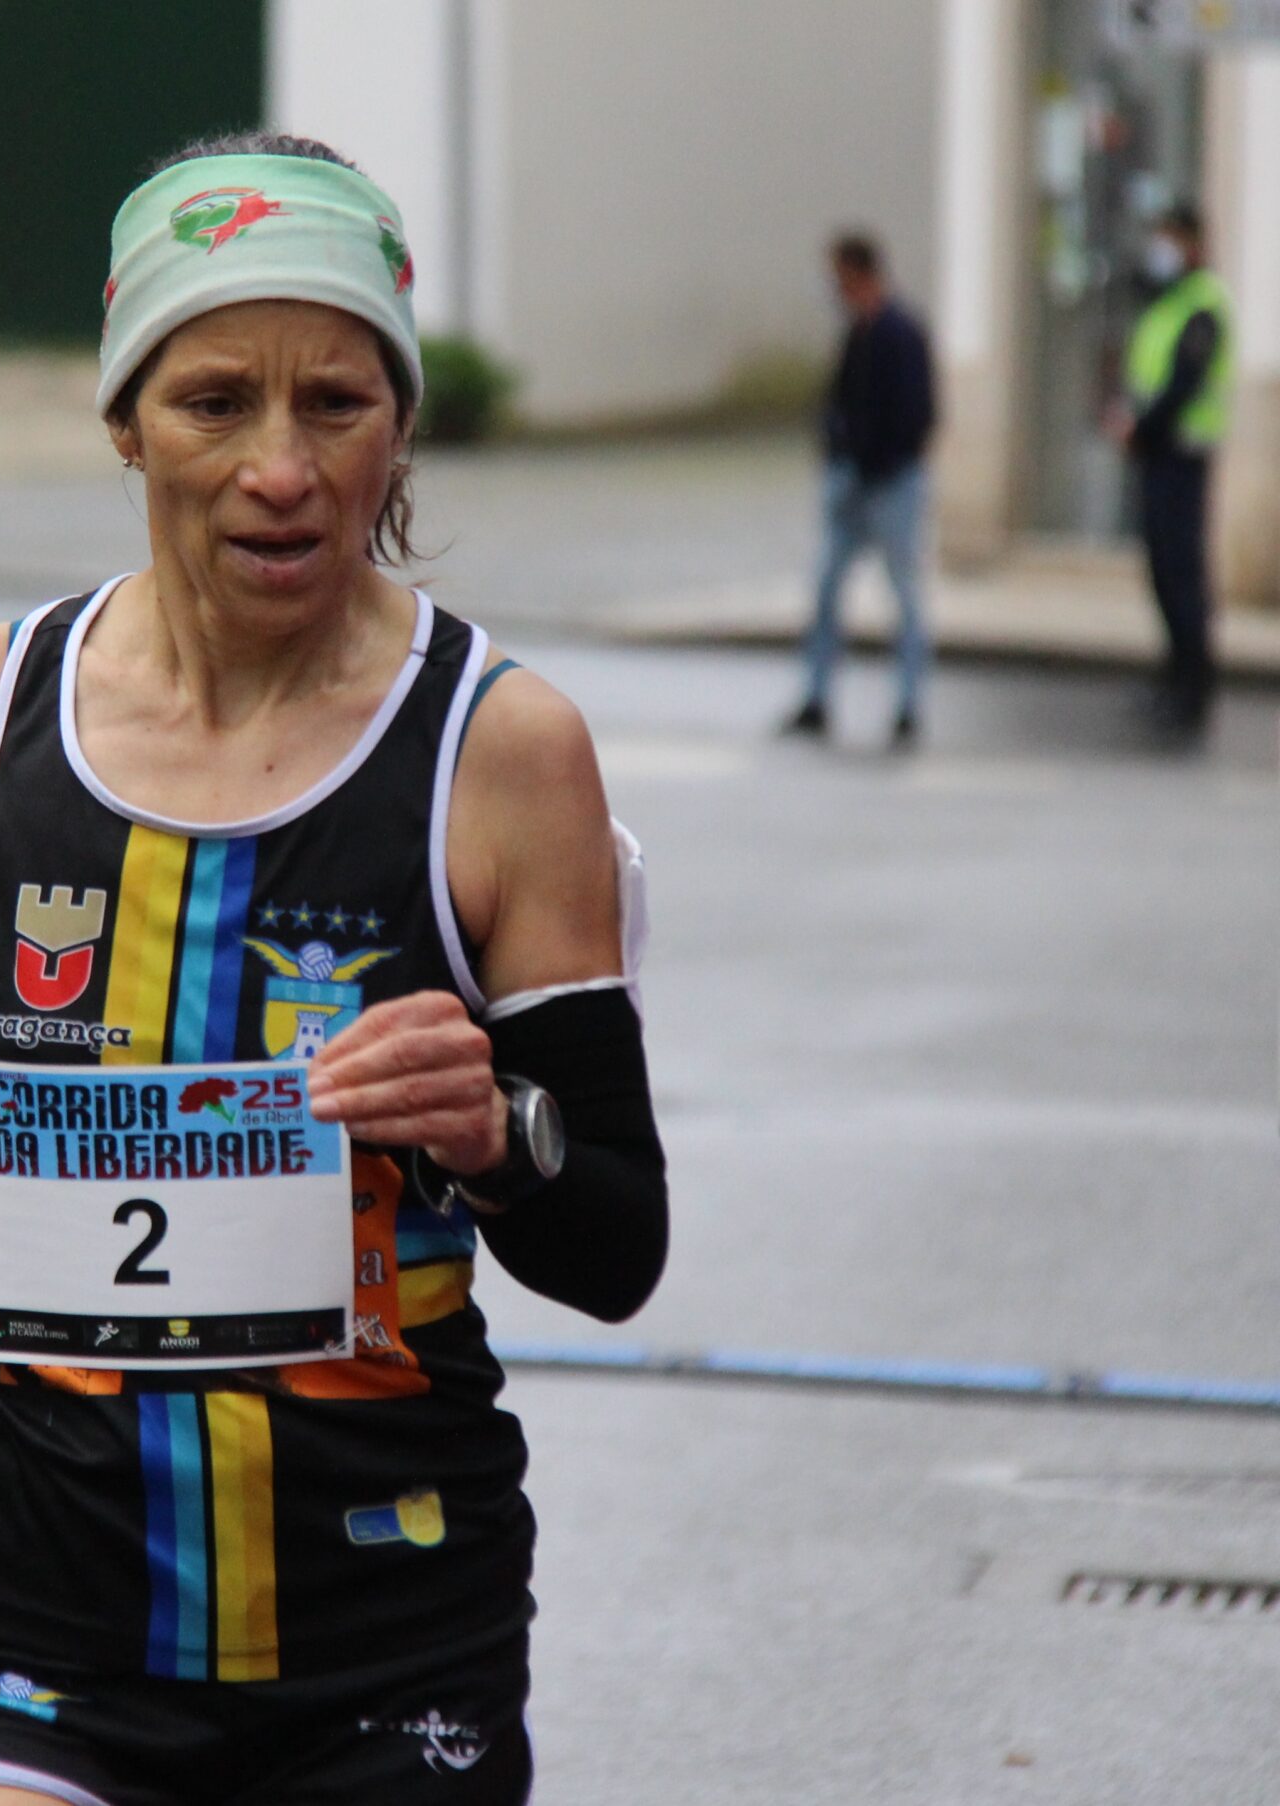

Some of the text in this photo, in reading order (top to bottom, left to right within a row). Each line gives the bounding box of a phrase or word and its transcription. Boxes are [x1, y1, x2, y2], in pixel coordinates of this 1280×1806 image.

[242, 1078, 302, 1110] 25
[242, 1110, 303, 1125] de Abril
[112, 1198, 170, 1285] 2
